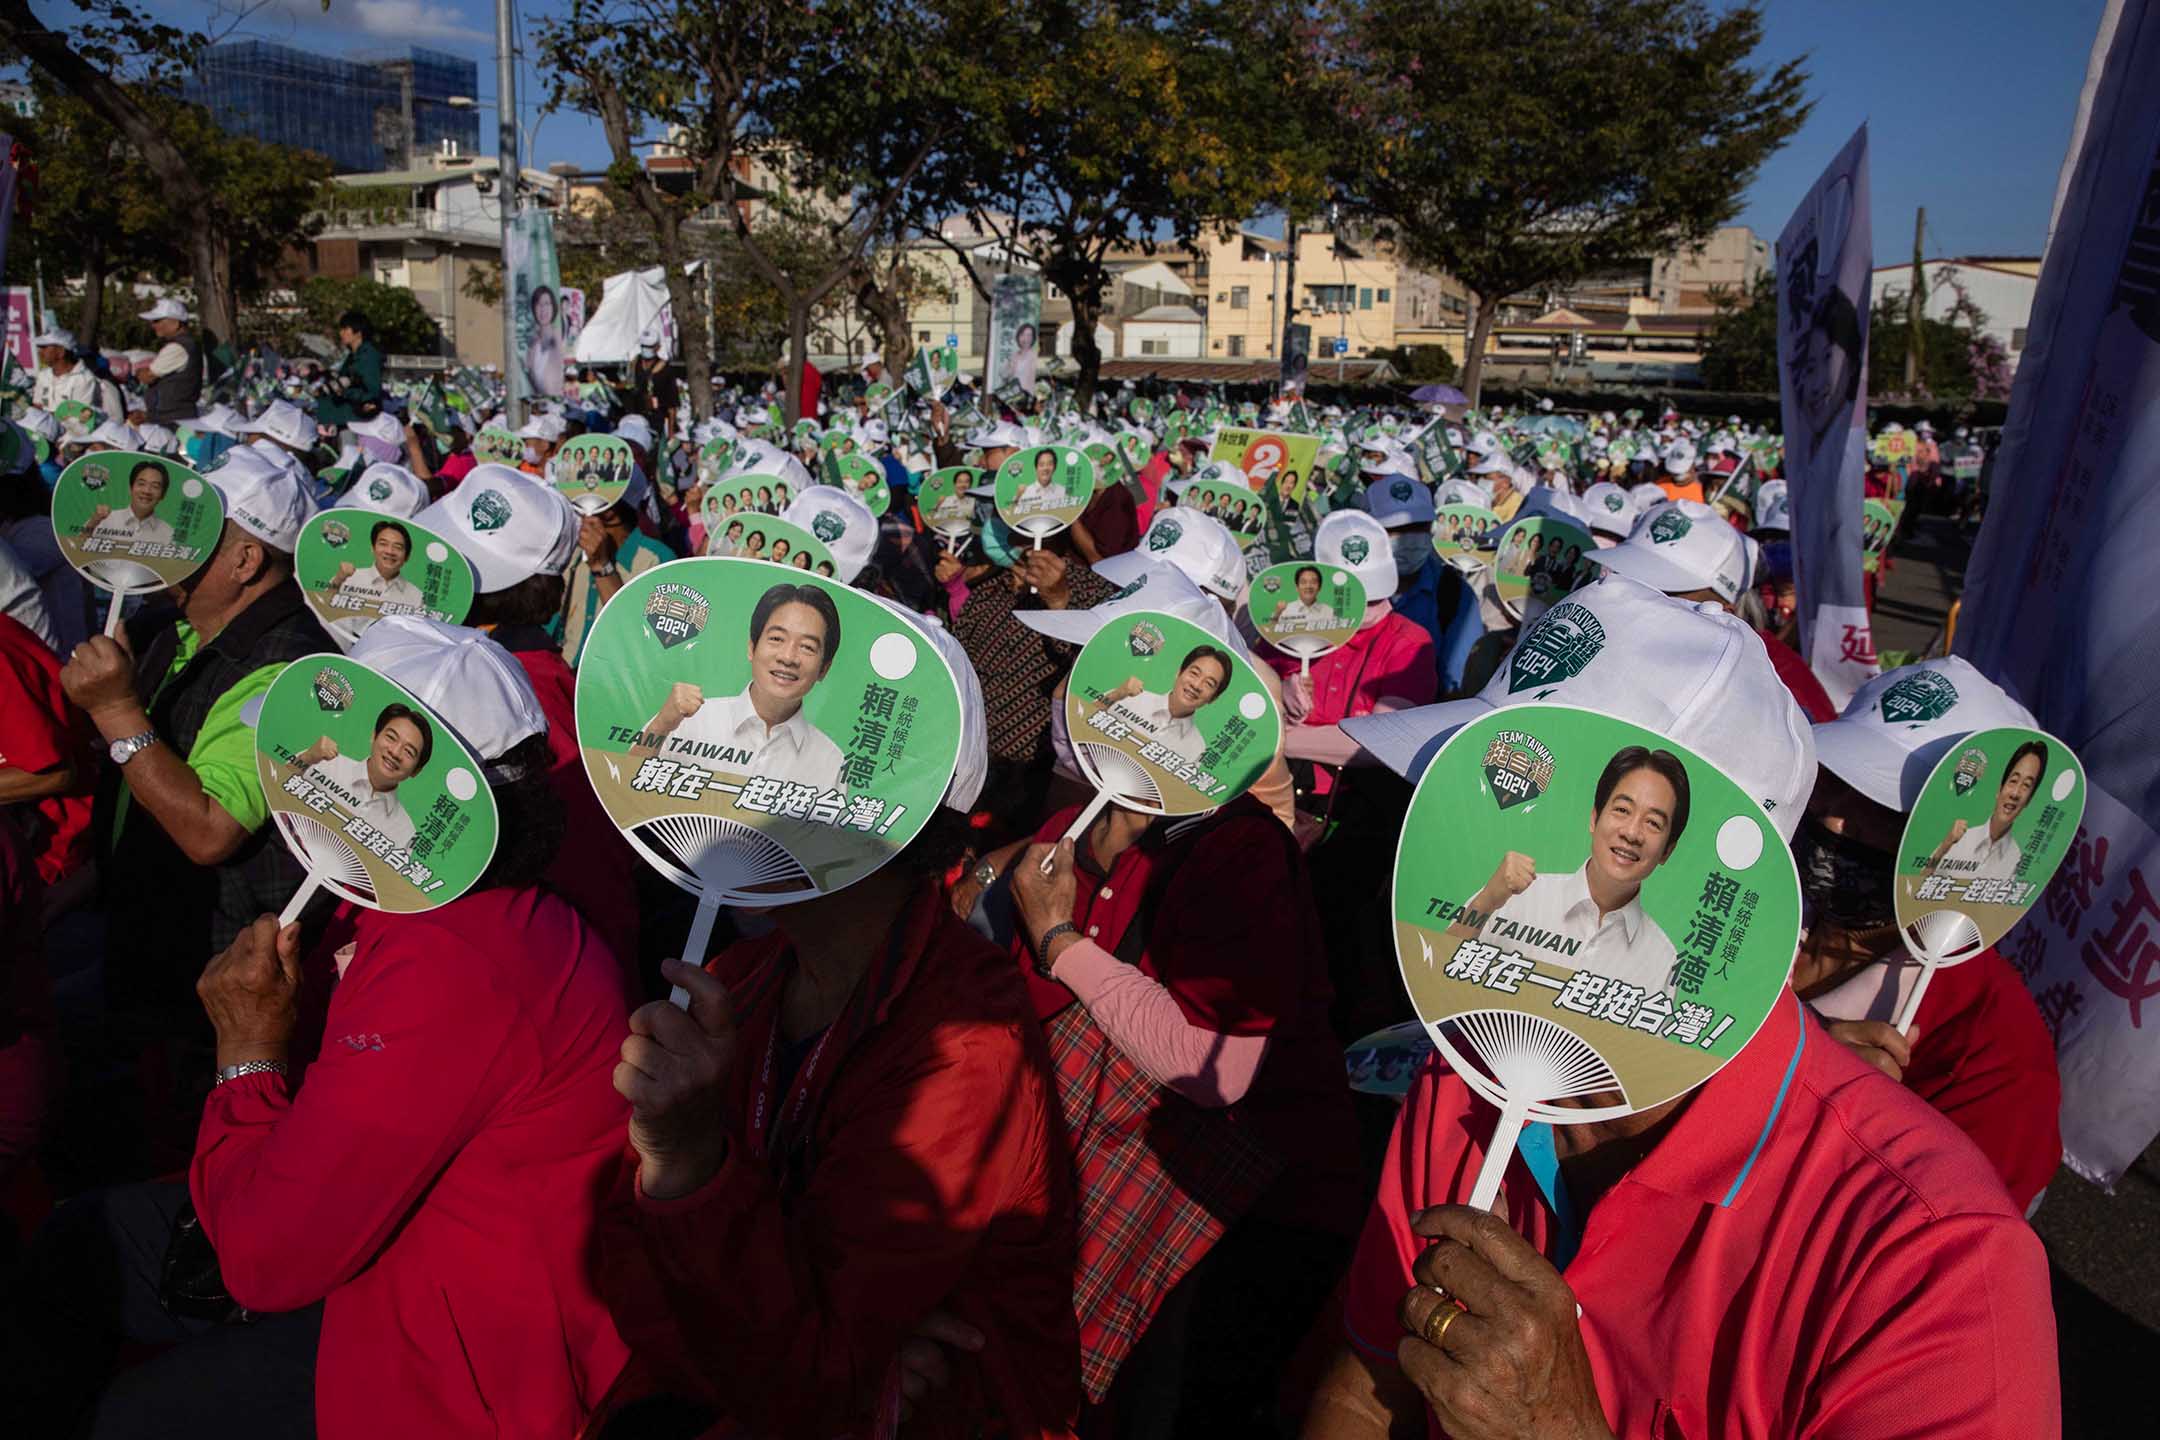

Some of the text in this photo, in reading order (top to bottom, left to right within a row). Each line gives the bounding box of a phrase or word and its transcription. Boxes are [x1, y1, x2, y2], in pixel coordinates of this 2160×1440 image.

[1248, 444, 1281, 480] 2
[96, 527, 134, 538] TAIWAN
[343, 585, 382, 597] TAIWAN
[655, 583, 710, 608] TEAM TAIWAN
[656, 616, 689, 638] 2024
[1568, 603, 1606, 643] TAIWAN
[1516, 648, 1559, 680] 2024
[318, 687, 340, 709] 2024
[1886, 695, 1924, 717] 2024
[839, 682, 900, 790] 賴清德
[881, 695, 919, 777] 總統候選人
[1113, 703, 1159, 734] TAIWAN
[607, 725, 754, 765] TEAM TAIWAN
[1497, 730, 1555, 764] TEAM TAIWAN
[273, 744, 362, 808] TEAM TAIWAN
[1481, 739, 1556, 793] 挺台灣
[1493, 768, 1530, 798] 2024
[630, 757, 907, 837] 賴在一起挺台灣!
[283, 774, 446, 894] 賴在一起挺台灣!
[409, 793, 460, 861] 賴清德
[1939, 857, 1980, 872] TAIWAN
[1425, 897, 1582, 957] TEAM TAIWAN
[1669, 870, 1741, 994] 賴清德
[1713, 888, 1760, 981] 總統候選人
[1444, 939, 1736, 1050] 賴在一起挺台灣!
